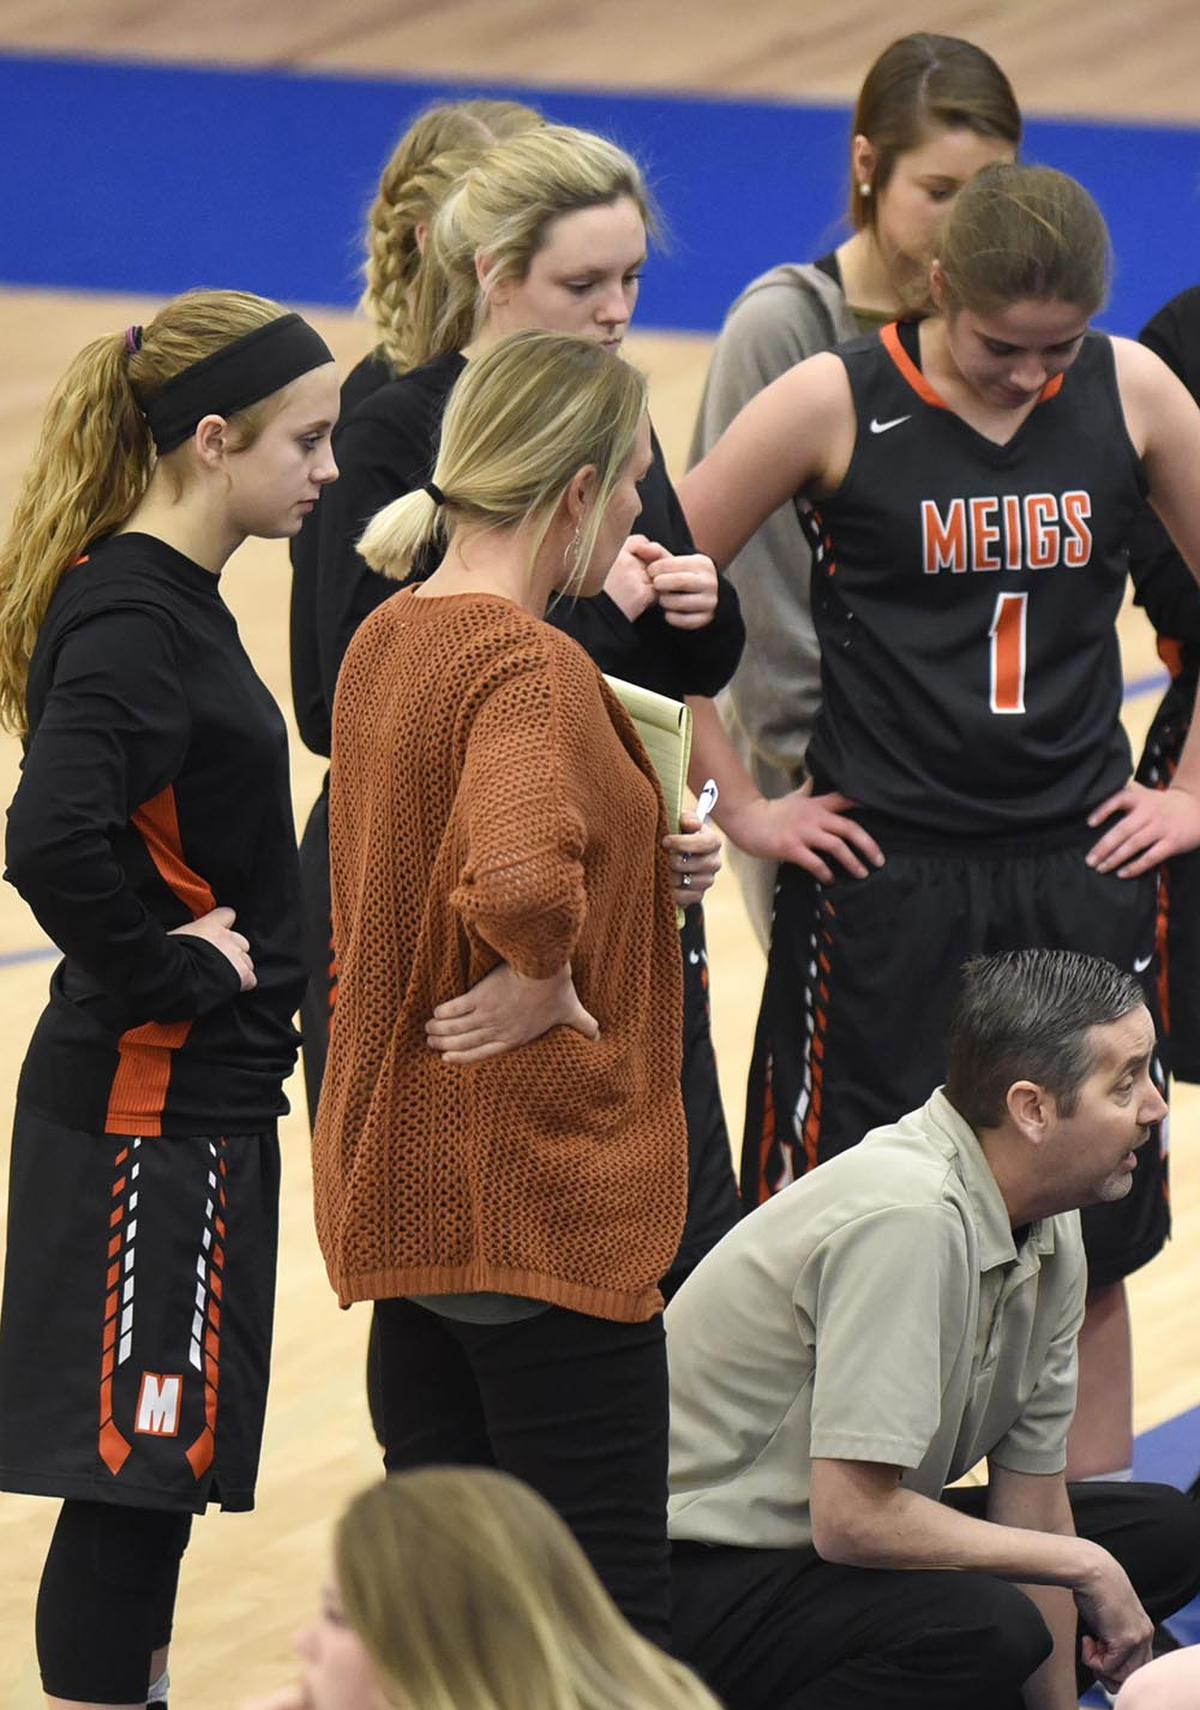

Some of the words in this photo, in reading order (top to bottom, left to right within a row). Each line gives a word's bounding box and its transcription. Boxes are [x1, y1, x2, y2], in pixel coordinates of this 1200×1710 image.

[921, 490, 1092, 574] MEIGS
[988, 592, 1028, 714] 1
[134, 1371, 183, 1437] M
